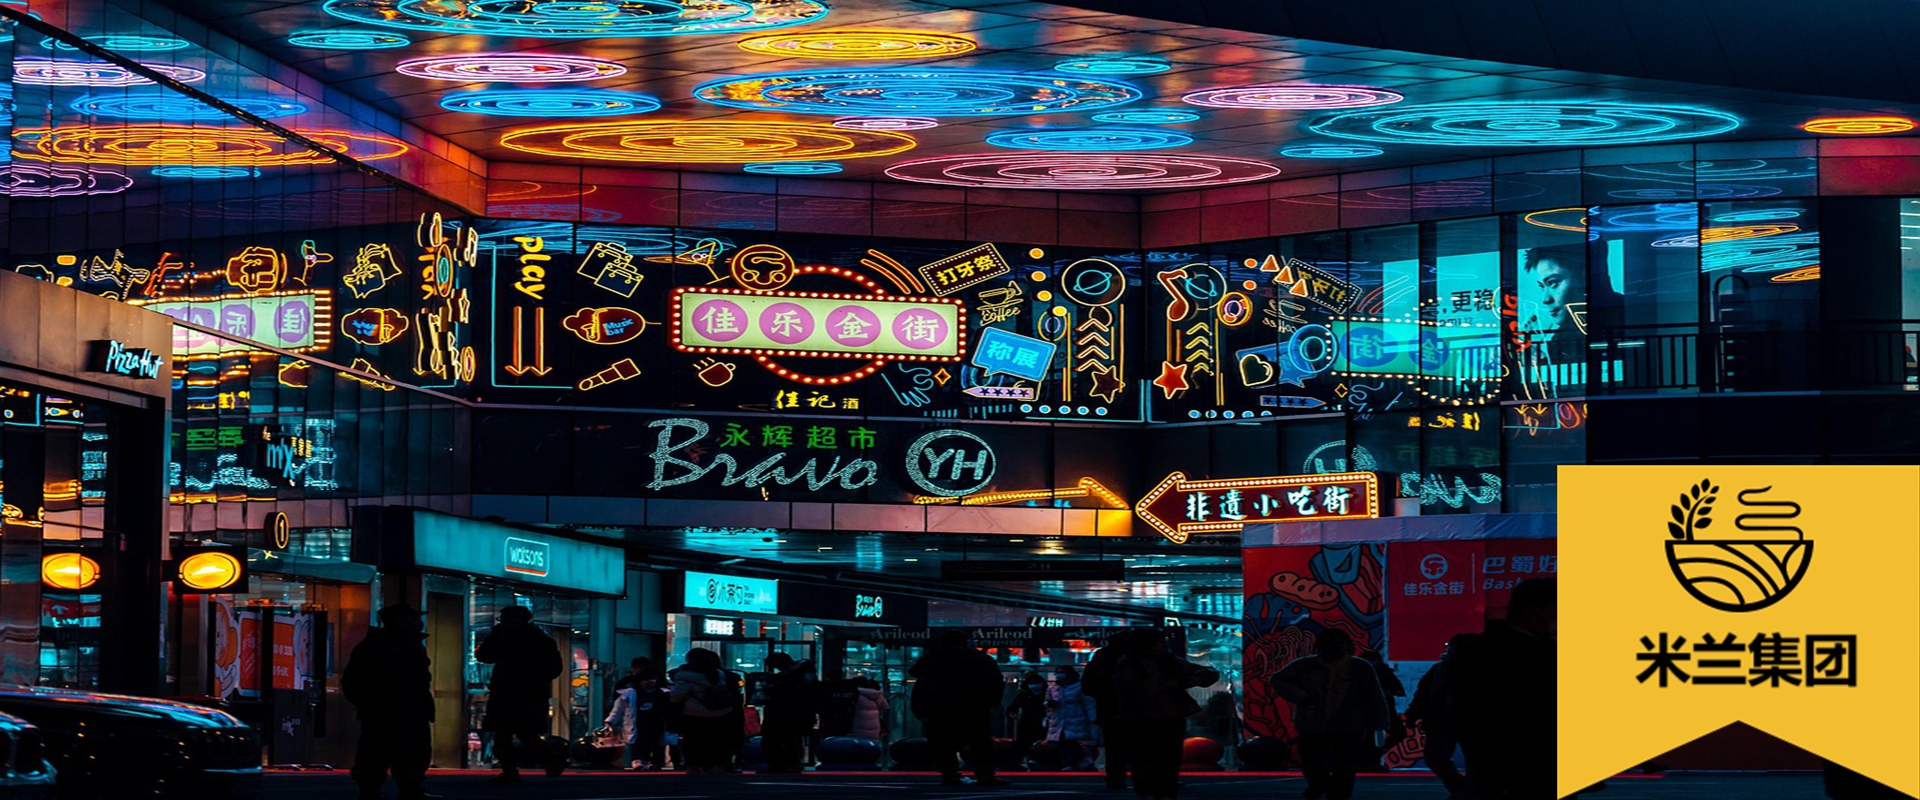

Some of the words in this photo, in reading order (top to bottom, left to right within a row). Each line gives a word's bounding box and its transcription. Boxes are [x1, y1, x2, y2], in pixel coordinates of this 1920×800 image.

[513, 236, 551, 300] play
[936, 254, 997, 286] 打牙祭
[603, 318, 634, 330] Music
[607, 327, 625, 337] bar
[700, 306, 940, 344] 佳乐金街
[106, 340, 140, 375] Pizza
[138, 348, 164, 379] Hut
[720, 422, 877, 450] 永辉超市
[646, 417, 879, 491] Bravo
[924, 446, 987, 481] YH
[509, 546, 544, 567] watsons
[1482, 554, 1557, 574] 巴蜀好
[1403, 581, 1465, 597] 佳乐金街
